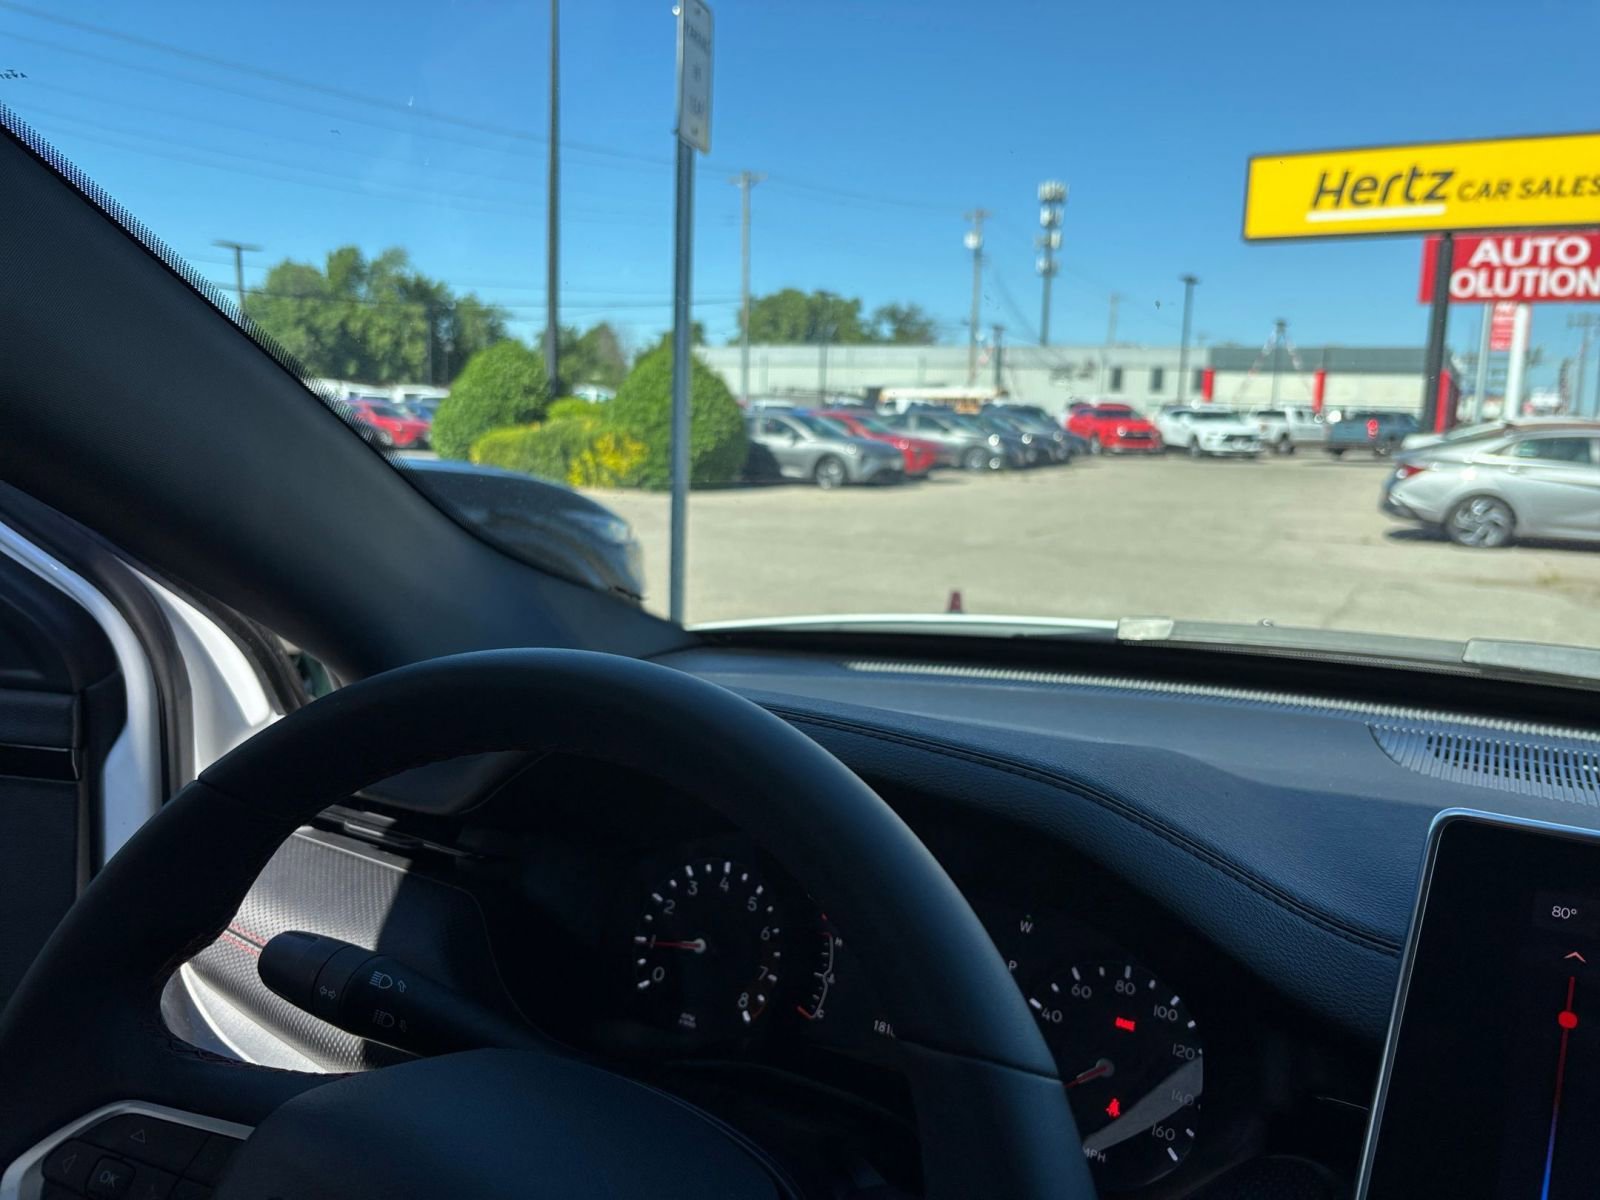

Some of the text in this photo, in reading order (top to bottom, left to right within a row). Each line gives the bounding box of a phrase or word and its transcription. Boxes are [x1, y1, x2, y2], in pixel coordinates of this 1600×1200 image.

[1311, 165, 1455, 209] Hertz
[1457, 179, 1513, 202] CAR
[1468, 234, 1592, 268] AUTO
[1449, 265, 1600, 299] OLUTION
[688, 880, 698, 896] 3
[720, 877, 730, 892] 4
[664, 900, 675, 915] 2
[747, 897, 757, 911] 5
[1551, 905, 1577, 919] 80°
[760, 926, 770, 941] 6
[1020, 920, 1034, 934] W
[653, 966, 665, 982] 0
[758, 966, 768, 981] 7
[1071, 984, 1092, 999] 60
[1114, 980, 1136, 996] 80
[738, 992, 749, 1008] 8
[1041, 1008, 1063, 1023] 40
[1153, 1004, 1178, 1021] 100
[1172, 1043, 1196, 1060] 120
[1171, 1089, 1194, 1106] 140
[1151, 1120, 1176, 1141] 160
